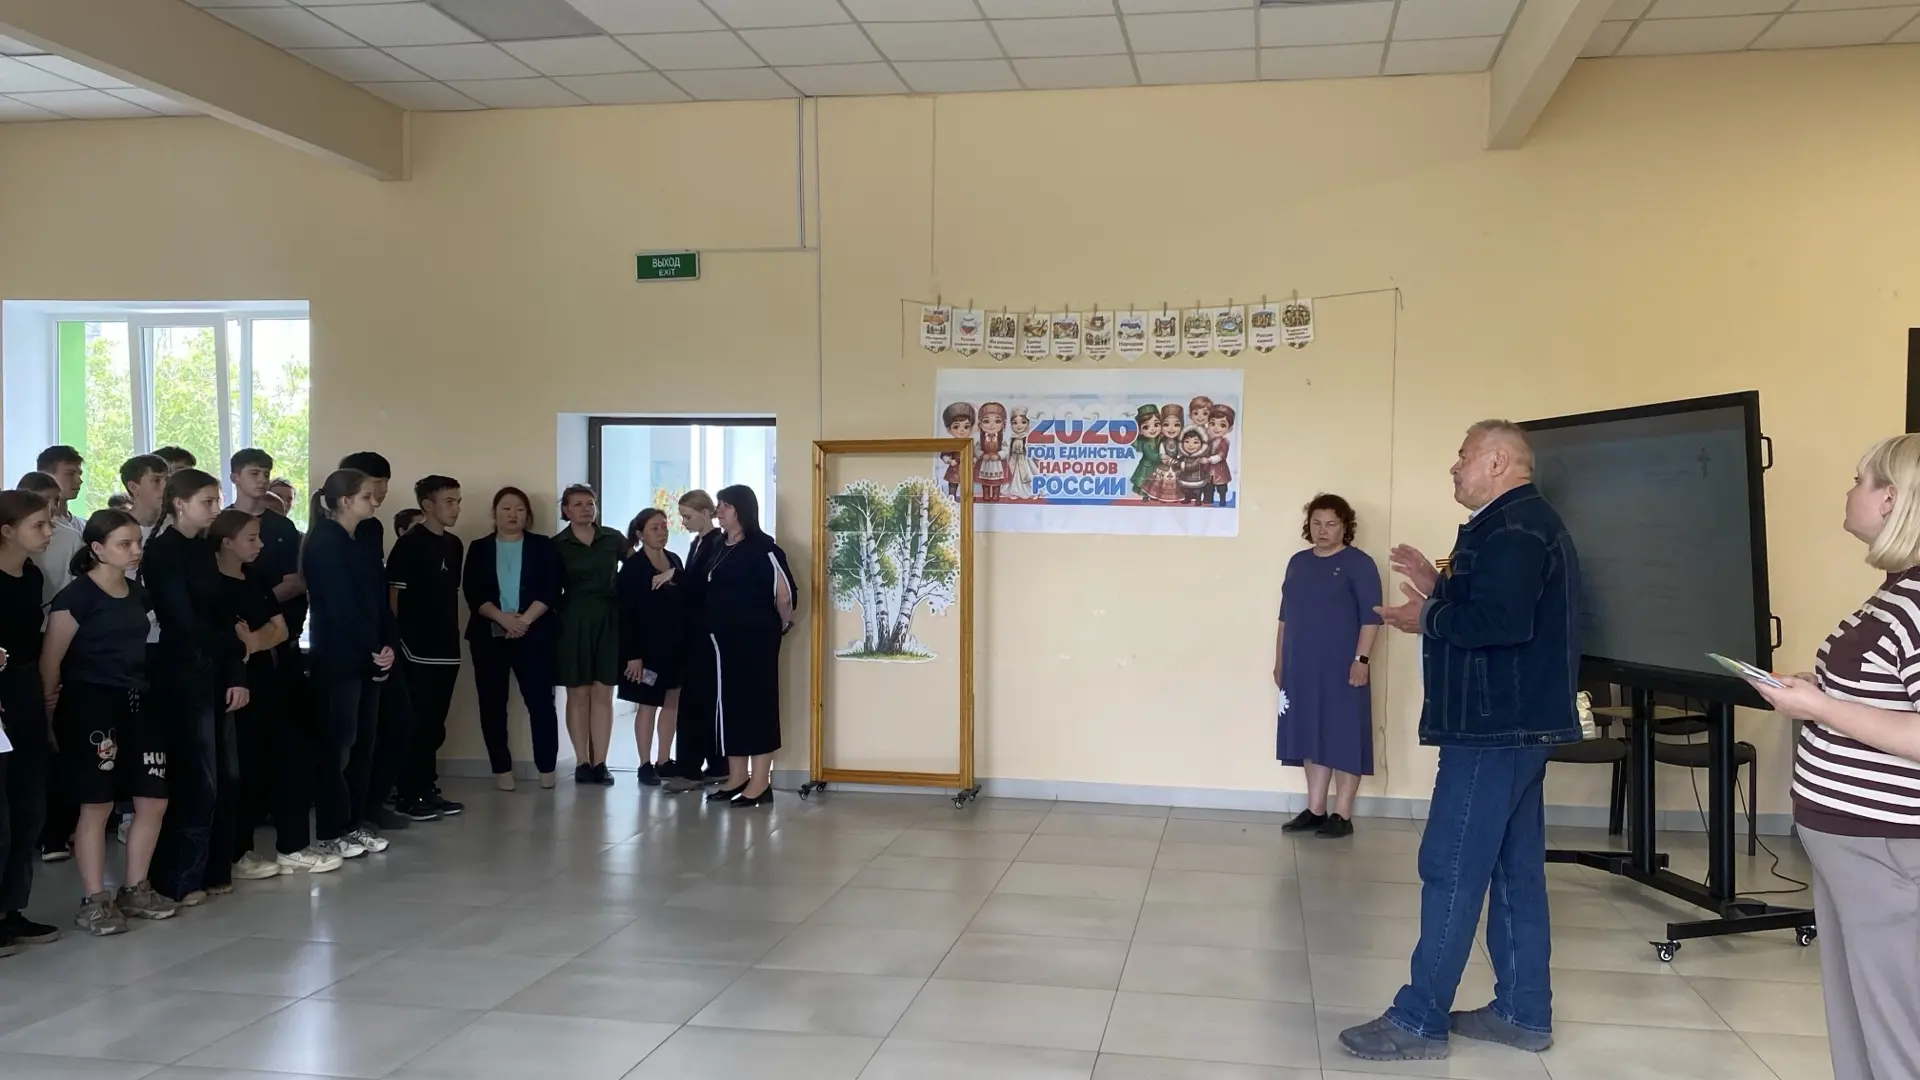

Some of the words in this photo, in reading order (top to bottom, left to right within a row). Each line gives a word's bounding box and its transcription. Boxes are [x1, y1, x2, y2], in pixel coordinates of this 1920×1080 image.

[652, 257, 681, 268] ВЫХОД
[1026, 403, 1139, 445] 2026
[1027, 447, 1055, 460] ГОД
[1059, 447, 1136, 460] ЕДИНСТВА
[1040, 461, 1118, 476] НАРОДОВ
[1032, 476, 1127, 496] РОССИИ
